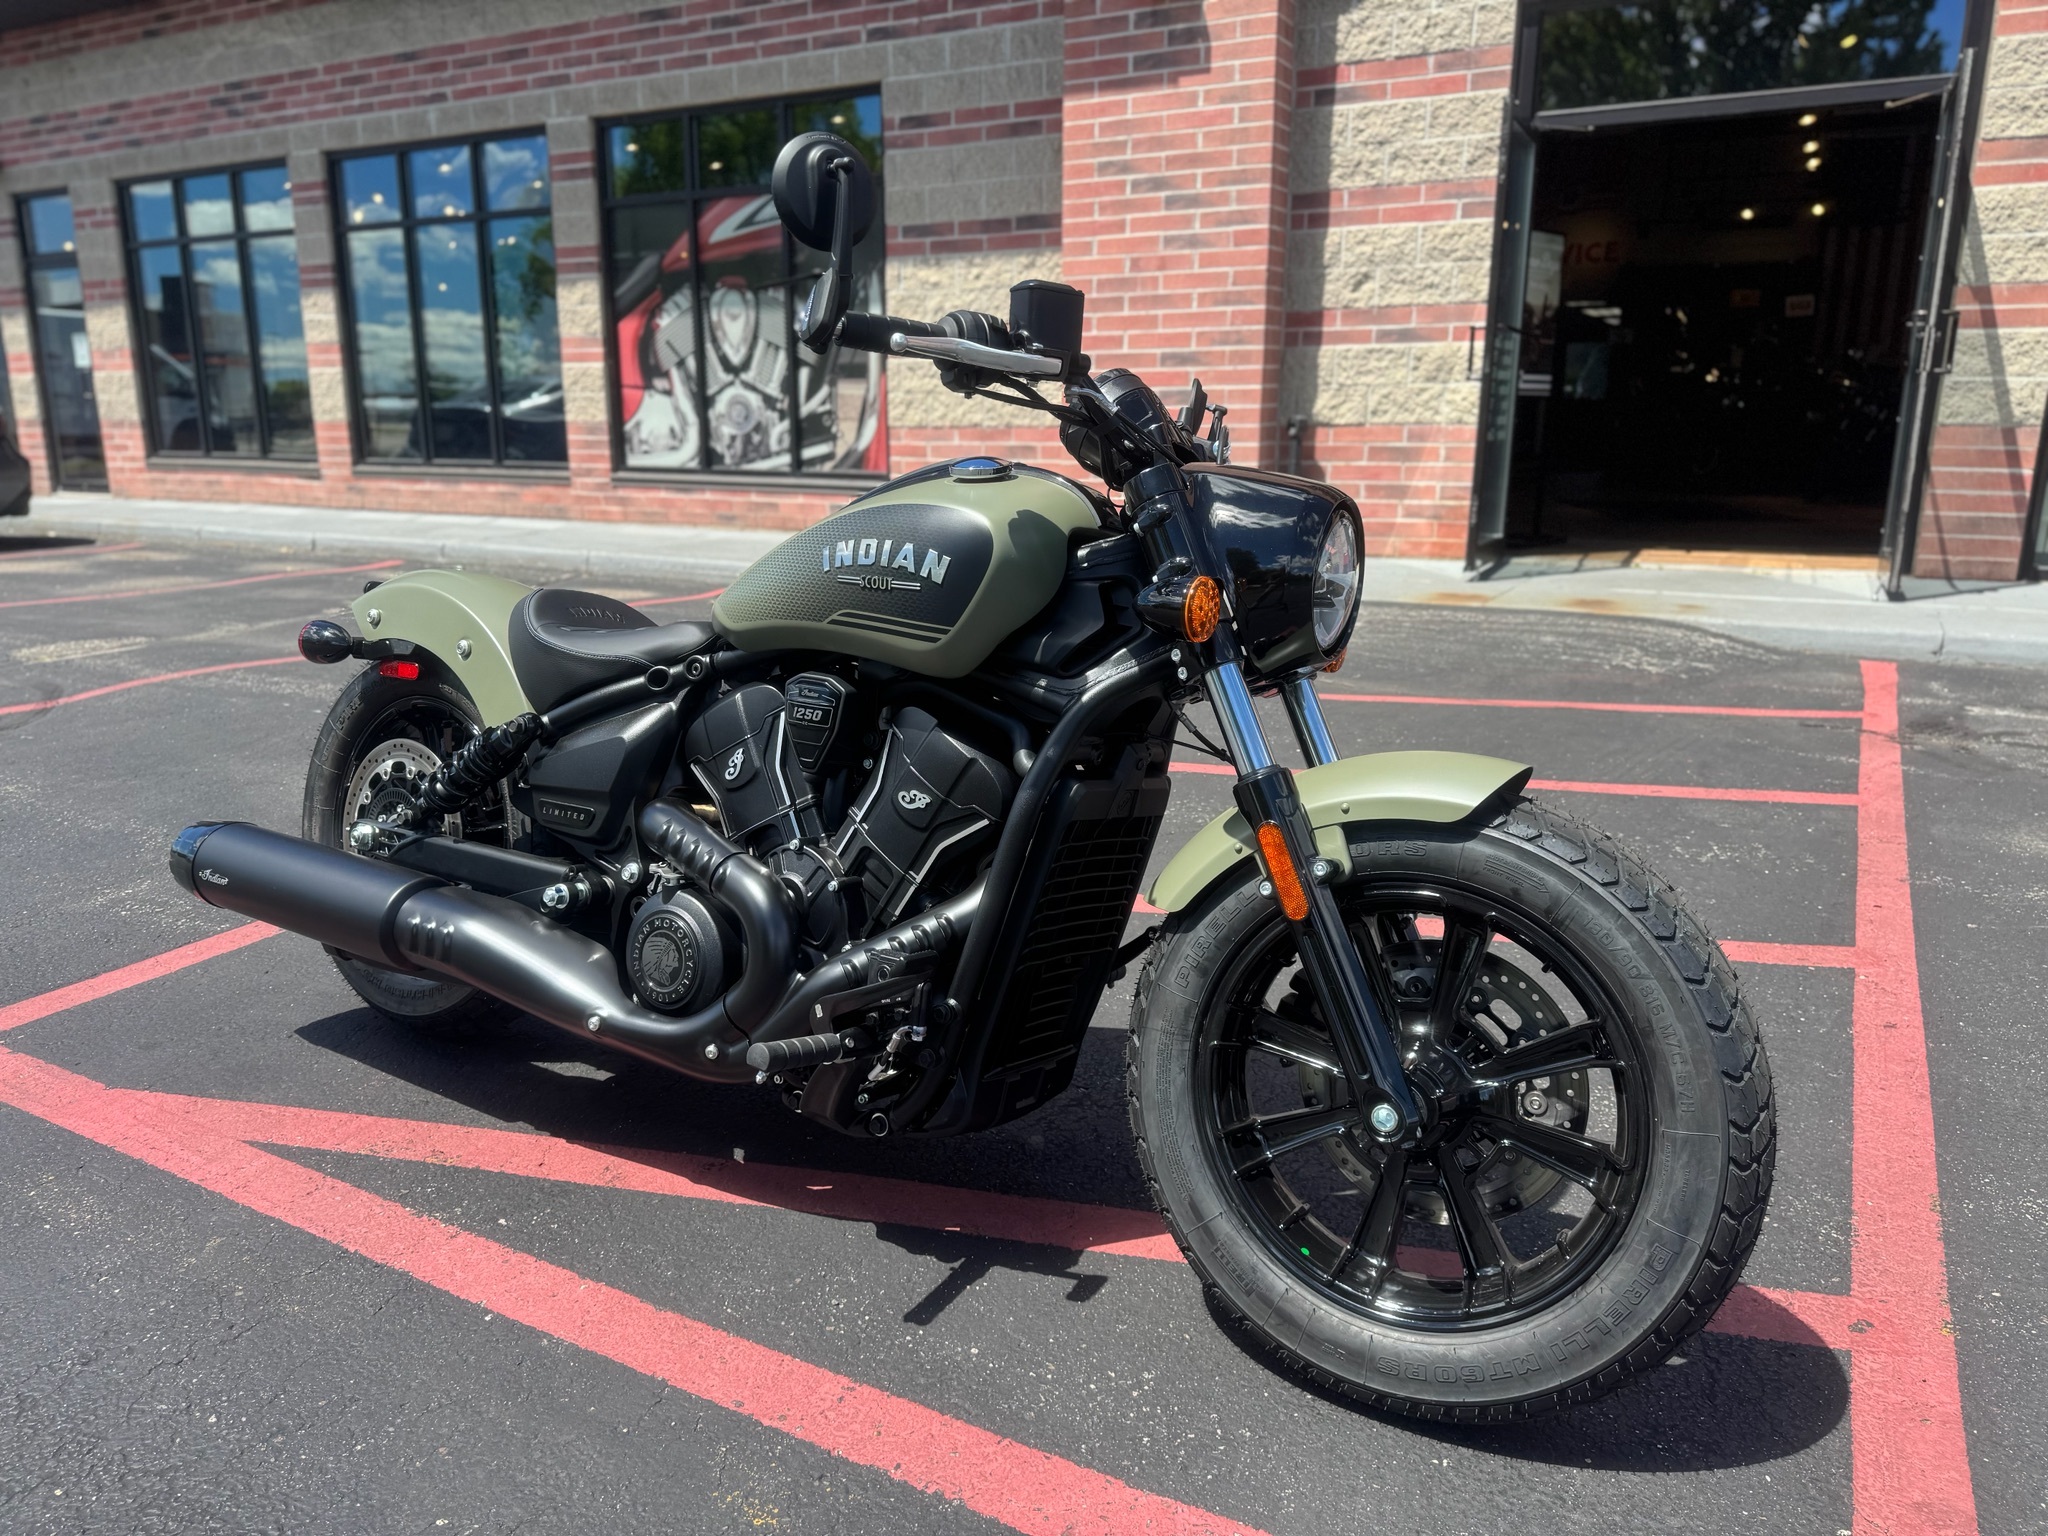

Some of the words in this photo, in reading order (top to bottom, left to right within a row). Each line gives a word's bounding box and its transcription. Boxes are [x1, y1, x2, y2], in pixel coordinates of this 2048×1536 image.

[822, 538, 951, 585] INDIAN
[860, 574, 893, 590] SCOUT
[793, 706, 823, 721] 1250
[542, 806, 586, 821] LIMITED
[1174, 878, 1262, 989] PIRELL
[633, 924, 651, 977] INDIAN
[654, 918, 694, 994] MOTORCYCLE
[1550, 1242, 1673, 1362] PIRELLI
[1376, 1353, 1542, 1383] MT60RS
